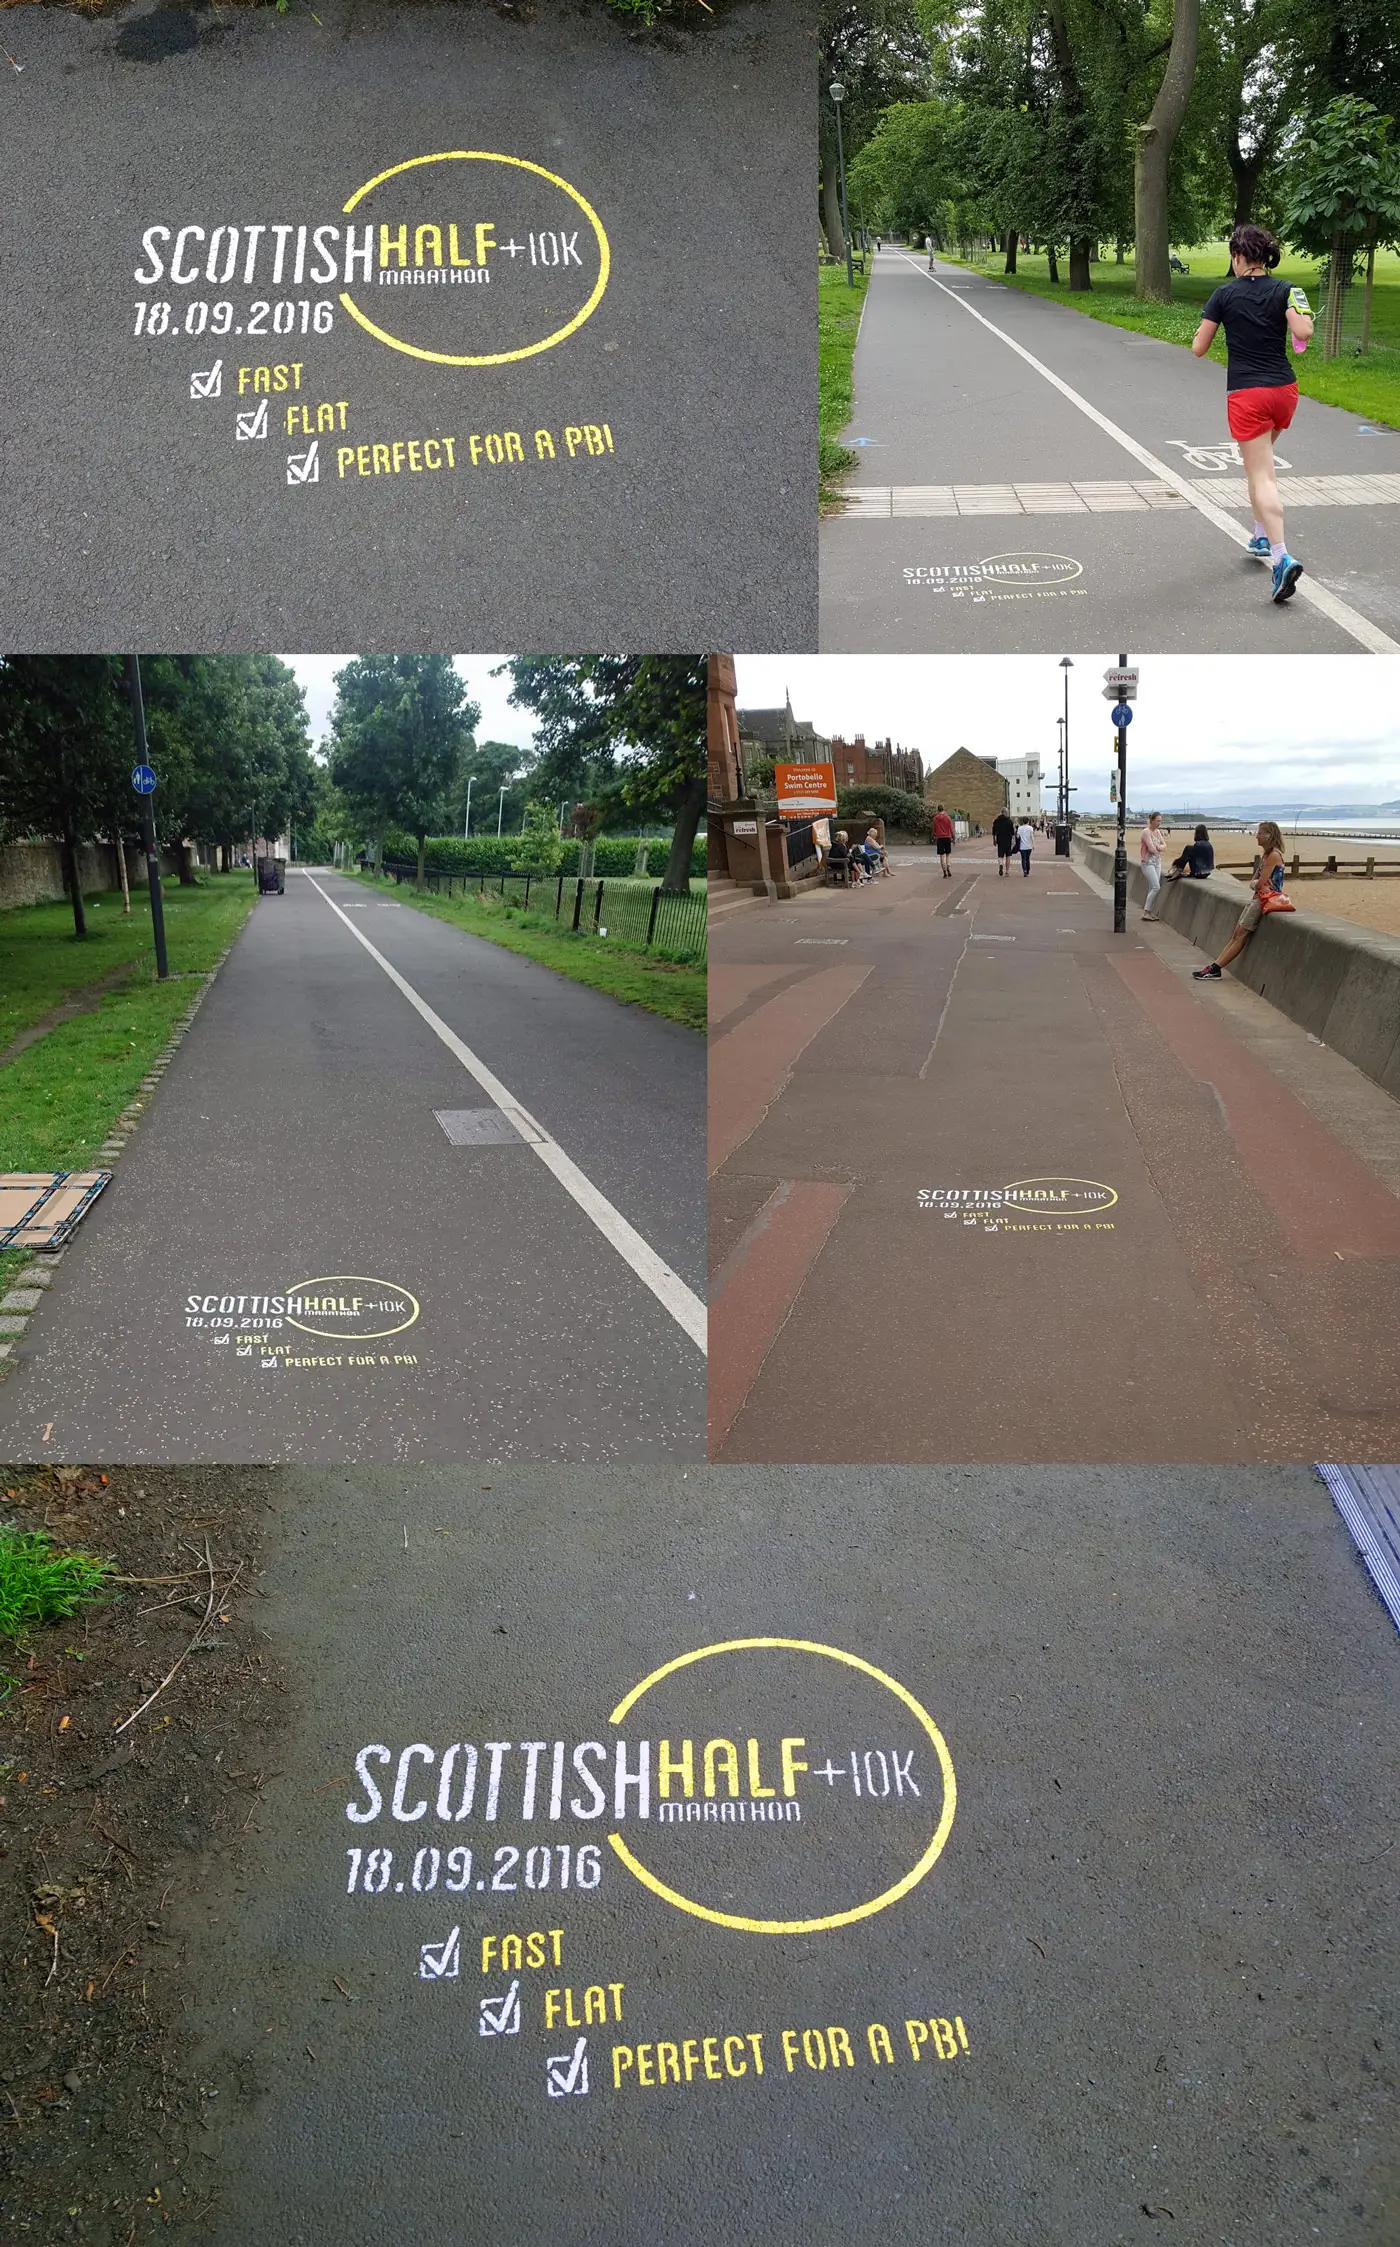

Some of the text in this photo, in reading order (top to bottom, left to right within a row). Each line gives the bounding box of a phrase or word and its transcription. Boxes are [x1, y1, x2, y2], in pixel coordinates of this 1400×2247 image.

[134, 225, 376, 284] SCOTTISH
[379, 224, 498, 267] HALF
[378, 268, 490, 285] MARATHON
[133, 301, 333, 336] 18.09.2016
[238, 363, 304, 395] FAST
[286, 401, 349, 435] FLAT
[337, 424, 615, 478] PERFECT FOR A PB!
[903, 565, 994, 577] SCOTTISH
[916, 1190, 1017, 1200] SCOTTISH
[185, 1296, 301, 1315] SCOTTISH
[305, 1298, 362, 1310] HALF
[186, 1317, 284, 1329] 18.09.2016
[236, 1335, 269, 1344] FAST
[261, 1346, 292, 1354] FLAT
[285, 1357, 342, 1367] PERFECT
[349, 1357, 375, 1365] FOR
[380, 1356, 390, 1364] A
[346, 1740, 650, 1824] SCOTTISH
[659, 1738, 807, 1798] HALF
[659, 1801, 801, 1823] MARATHON
[346, 1845, 601, 1894] 18.09.2016
[481, 1930, 564, 1973] FAST
[545, 1983, 624, 2029] FLAT
[612, 2017, 970, 2089] PERFECT FOR A PB!
